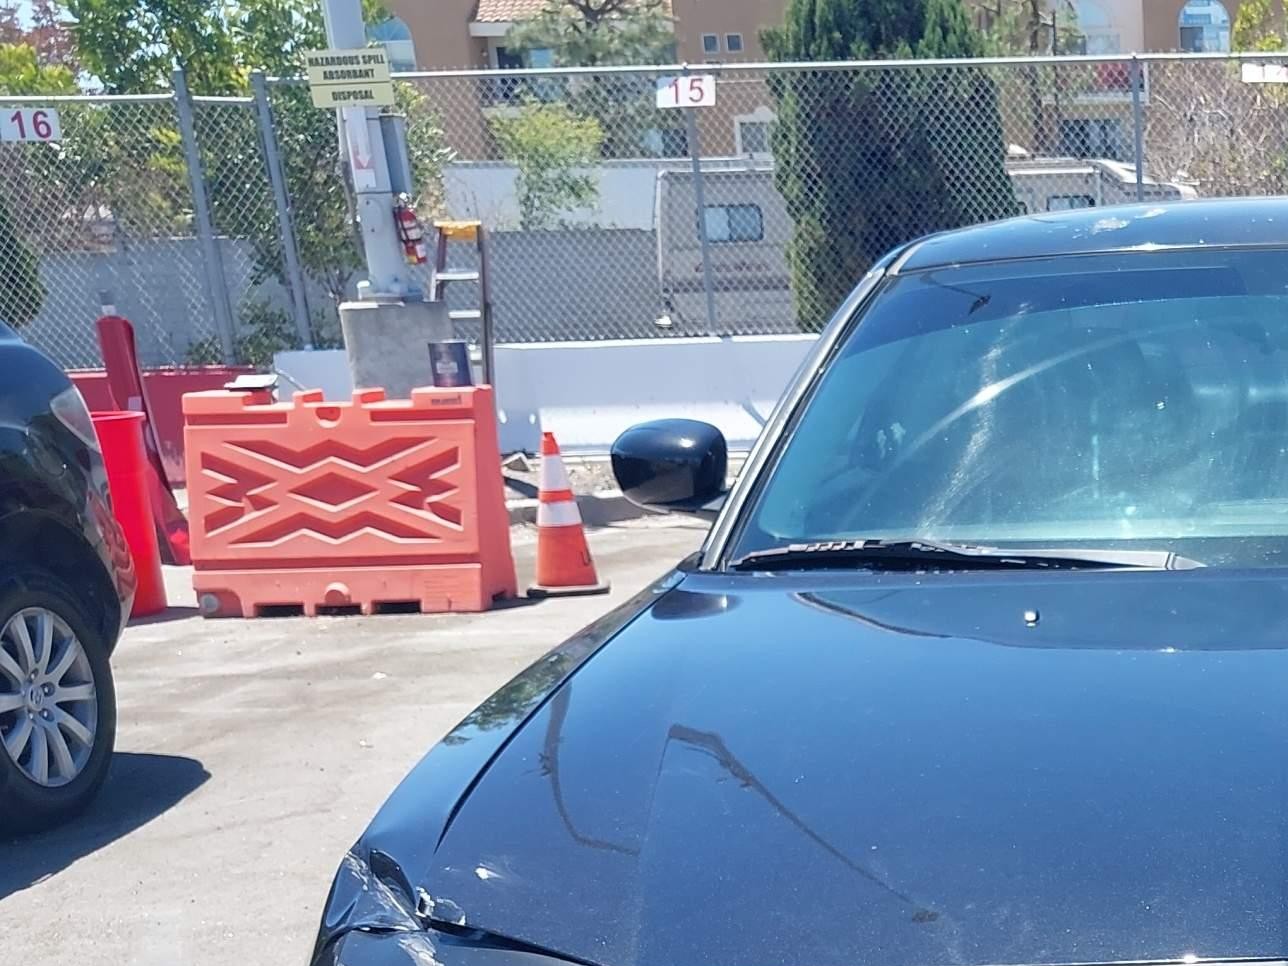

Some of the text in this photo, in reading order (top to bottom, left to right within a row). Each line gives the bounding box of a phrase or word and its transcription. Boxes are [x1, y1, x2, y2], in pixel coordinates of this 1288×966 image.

[308, 54, 385, 67] HAZARDOUS SPILL
[332, 90, 374, 101] DISPOSAL
[668, 78, 704, 104] 15
[11, 110, 52, 139] 16
